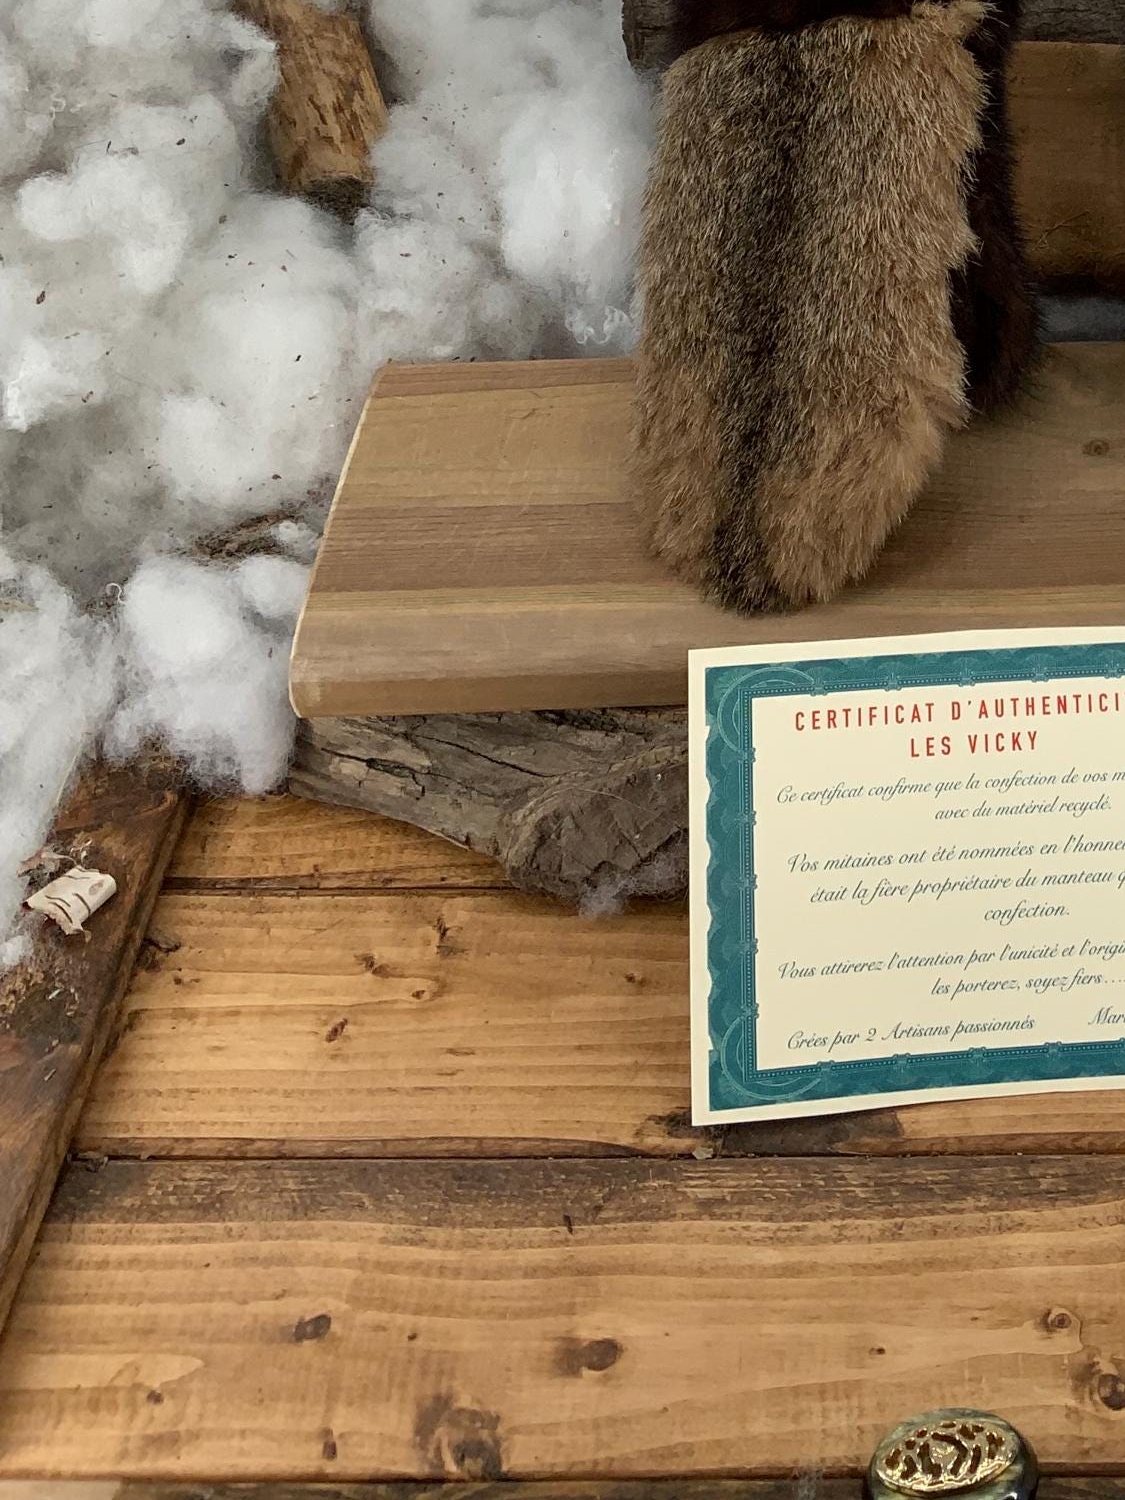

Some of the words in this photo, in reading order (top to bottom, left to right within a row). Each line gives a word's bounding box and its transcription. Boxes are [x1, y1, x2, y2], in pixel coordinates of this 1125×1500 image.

[795, 703, 935, 731] CERTIFICAT
[911, 737, 951, 757] LES
[968, 731, 1038, 753] VICKY
[777, 785, 798, 804] Ce
[800, 782, 864, 806] certificat
[868, 777, 932, 800] confirme
[935, 780, 962, 798] que
[965, 772, 981, 789] la
[985, 770, 1057, 793] confection
[1061, 767, 1079, 785] de
[1083, 773, 1107, 783] vos
[934, 808, 969, 820] avec
[972, 801, 992, 817] du
[995, 796, 1060, 817] matériel
[1058, 793, 1112, 818] recyclé.
[787, 853, 818, 873] Vos
[824, 851, 893, 870] mitaines
[898, 849, 928, 865] ont
[931, 845, 955, 861] été
[958, 841, 1034, 860] nommées
[1040, 843, 1058, 856] en
[810, 884, 848, 903] était
[851, 880, 868, 900] la
[861, 877, 909, 905] fière
[907, 875, 1013, 903] propriétaire
[1015, 868, 1038, 887] du
[1041, 870, 1114, 887] manteau
[984, 900, 1070, 926] confection.
[778, 961, 816, 979] Vous
[820, 958, 884, 976] attirerez
[887, 952, 964, 971] l'attention
[964, 949, 996, 971] par
[999, 943, 1058, 962] l'unicité
[1061, 944, 1077, 957] et
[931, 977, 951, 996] les
[951, 979, 1021, 1000] porterez,
[1025, 974, 1069, 995] soyez
[787, 1030, 828, 1049] Crées
[828, 1030, 860, 1052] par
[866, 1028, 877, 1041] 2
[881, 1021, 950, 1040] Artisans
[950, 1015, 1035, 1041] passionnés
